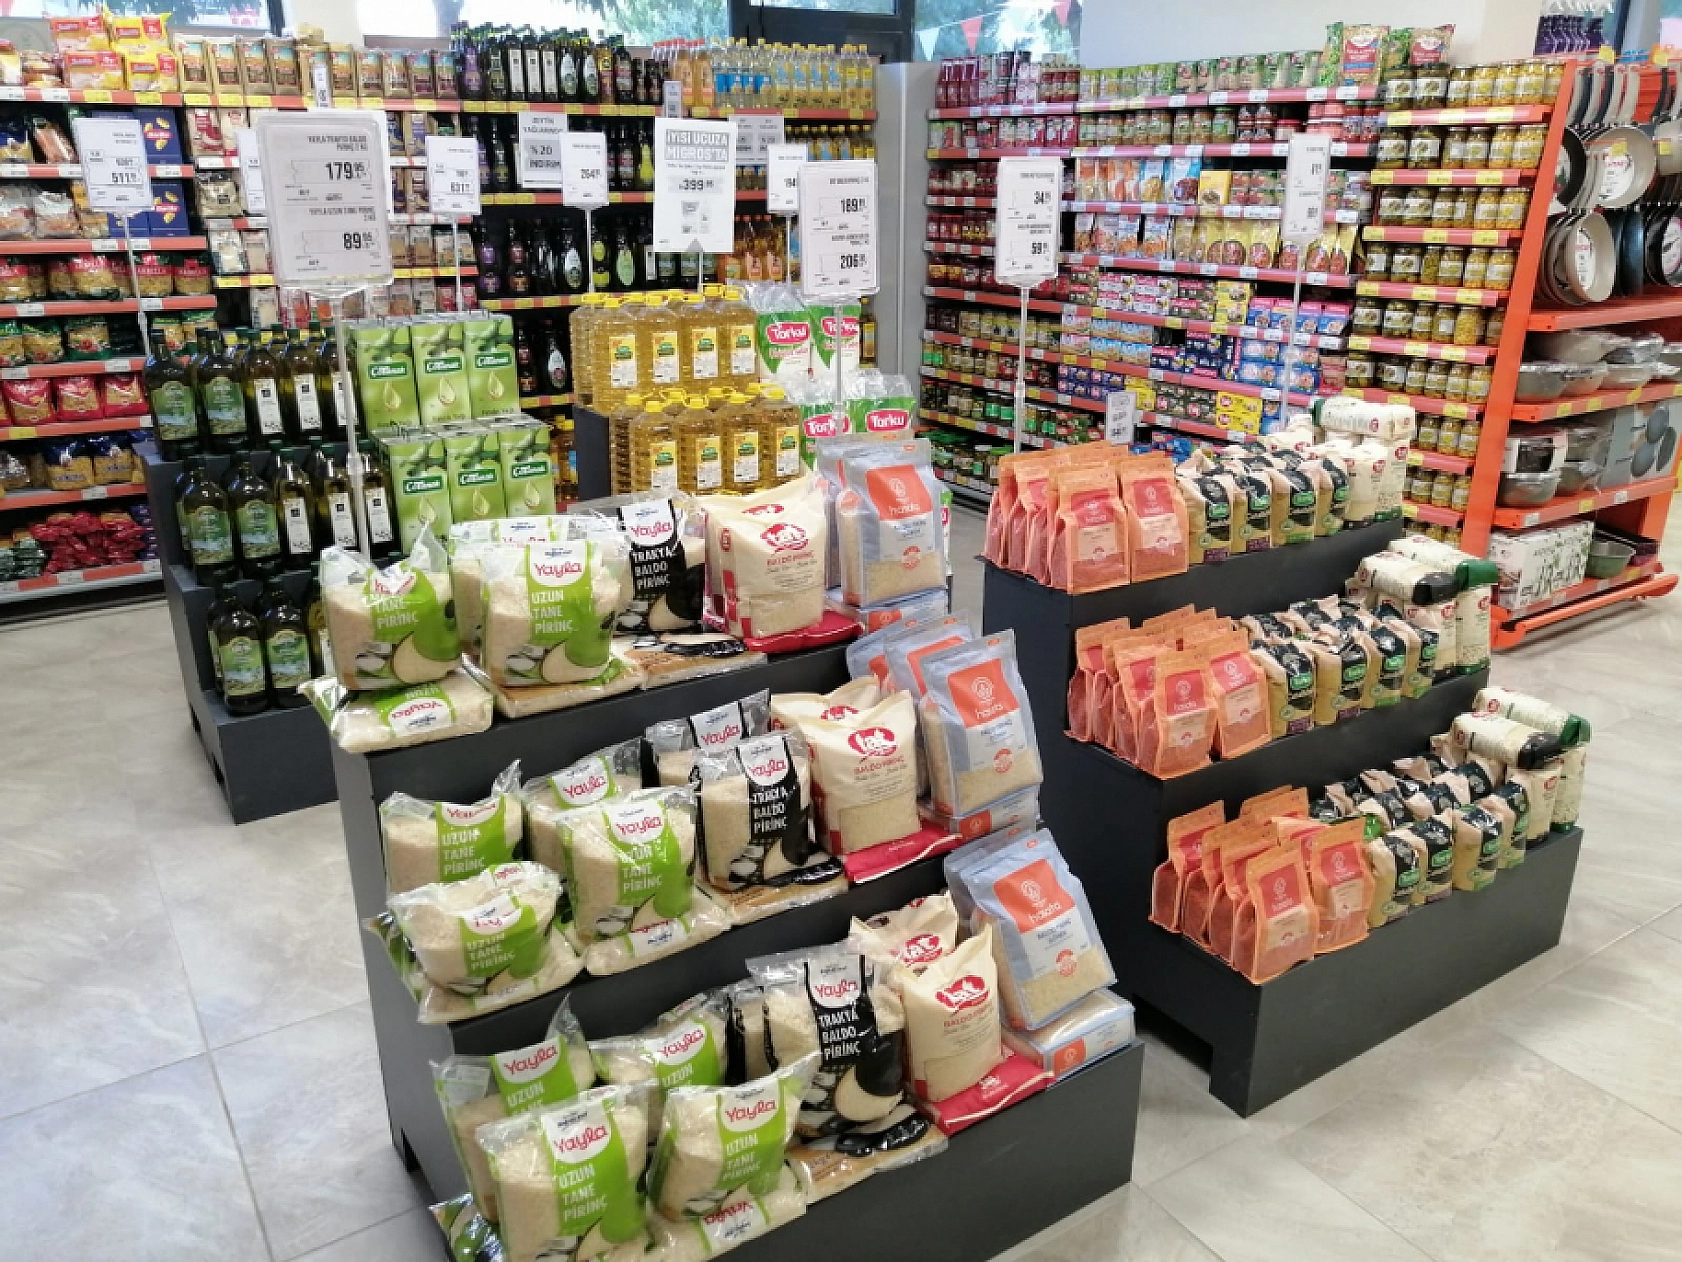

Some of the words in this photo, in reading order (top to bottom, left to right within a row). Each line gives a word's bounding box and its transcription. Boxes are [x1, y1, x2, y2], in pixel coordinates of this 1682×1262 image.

[539, 145, 553, 155] 20
[325, 162, 353, 181] 179
[343, 232, 362, 250] 89
[771, 325, 807, 340] Torku
[870, 415, 904, 428] Torku
[631, 520, 673, 538] Yayla
[534, 562, 582, 578] Yayla
[701, 723, 740, 746] Yayla
[749, 759, 787, 777] Yayla
[616, 815, 663, 835] Yayla
[814, 979, 859, 999] Yayla
[818, 1006, 860, 1029] TRAKYA
[659, 1028, 704, 1058] Yayla
[821, 1027, 857, 1045] BALDO
[504, 1045, 558, 1074] Yayla
[507, 1082, 545, 1106] UZUN
[725, 1099, 776, 1123] Yayla
[554, 1124, 608, 1153] Yayla
[558, 1164, 596, 1188] UZUN
[562, 1184, 596, 1204] TANE
